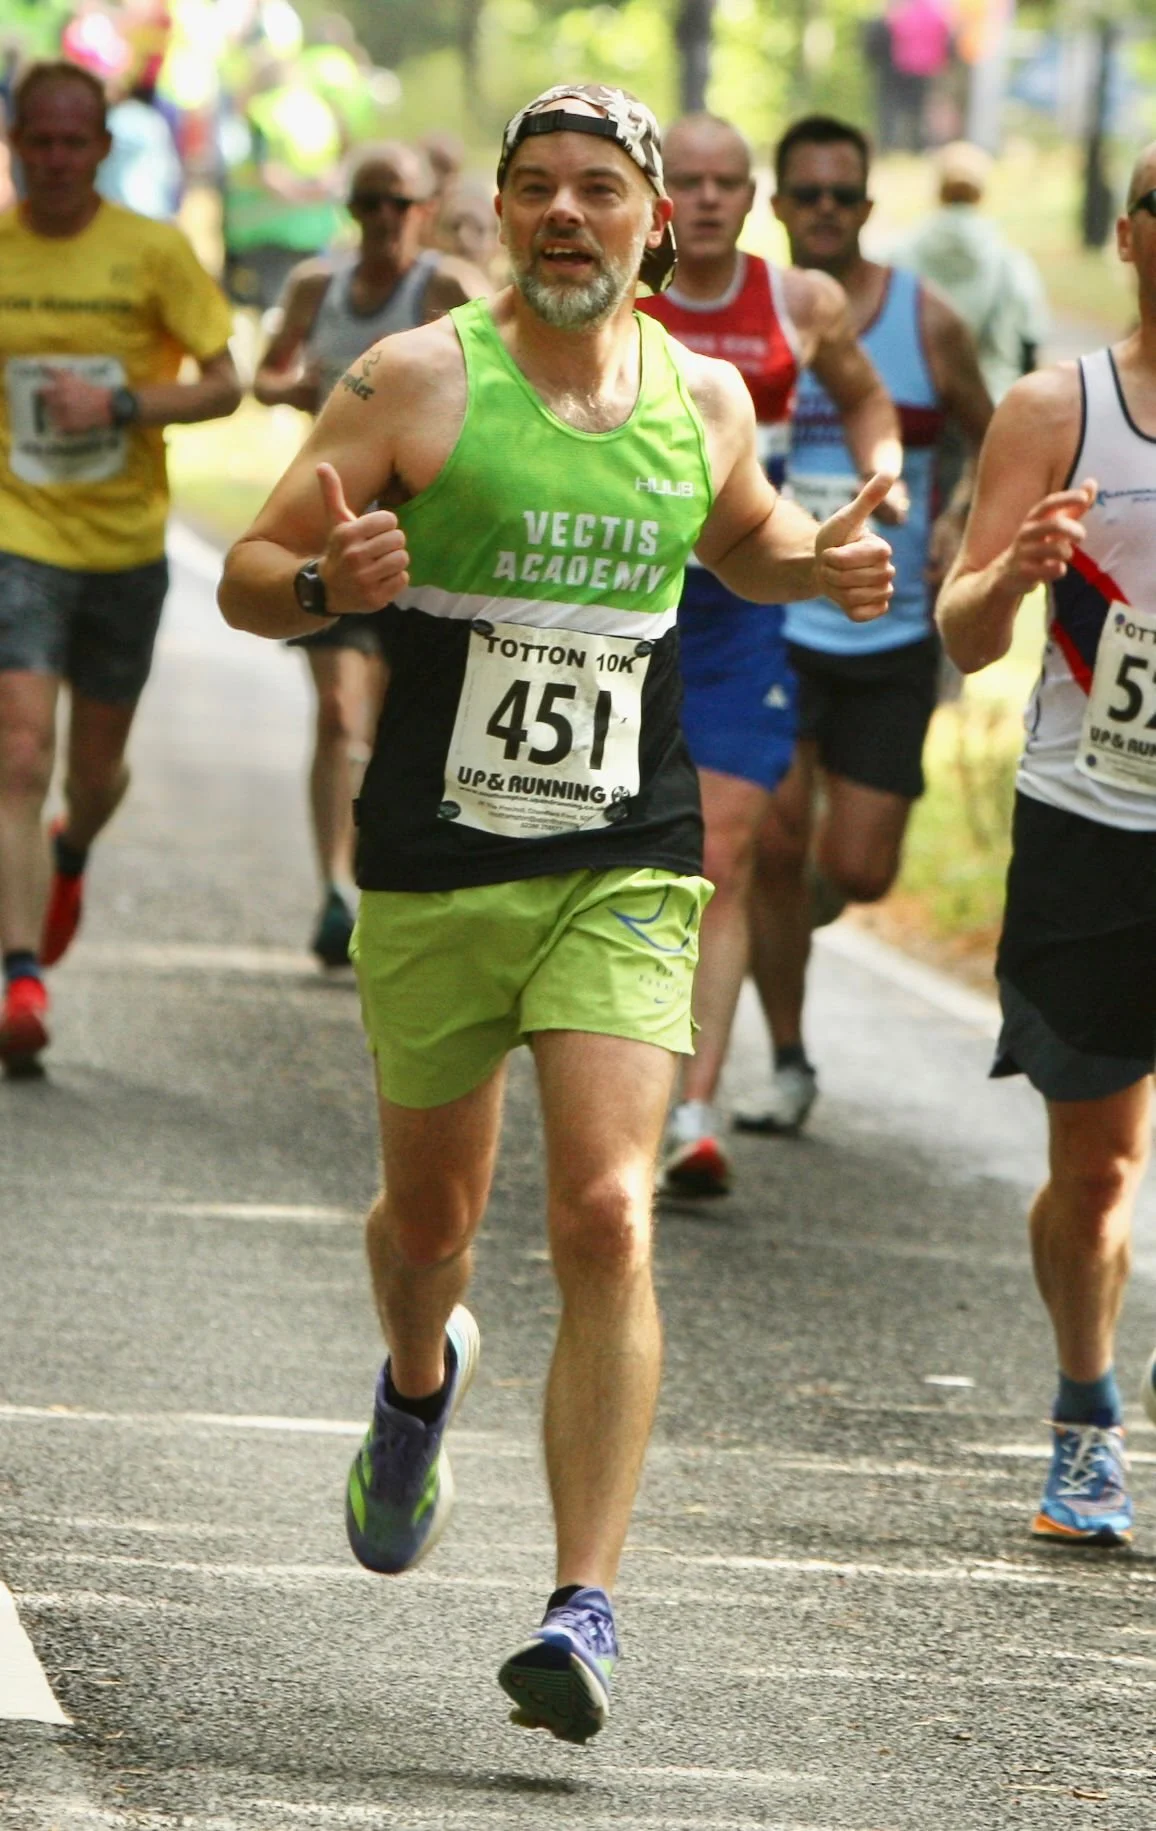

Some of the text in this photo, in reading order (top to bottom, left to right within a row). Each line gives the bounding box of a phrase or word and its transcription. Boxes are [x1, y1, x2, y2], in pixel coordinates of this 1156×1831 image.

[635, 477, 695, 497] HUUB
[523, 510, 660, 556] VECTIS
[493, 551, 667, 594] ACADEMY
[484, 636, 587, 668] TOTTON
[597, 653, 639, 674] 10K
[486, 679, 612, 771] 451
[508, 775, 607, 804] RUNNING
